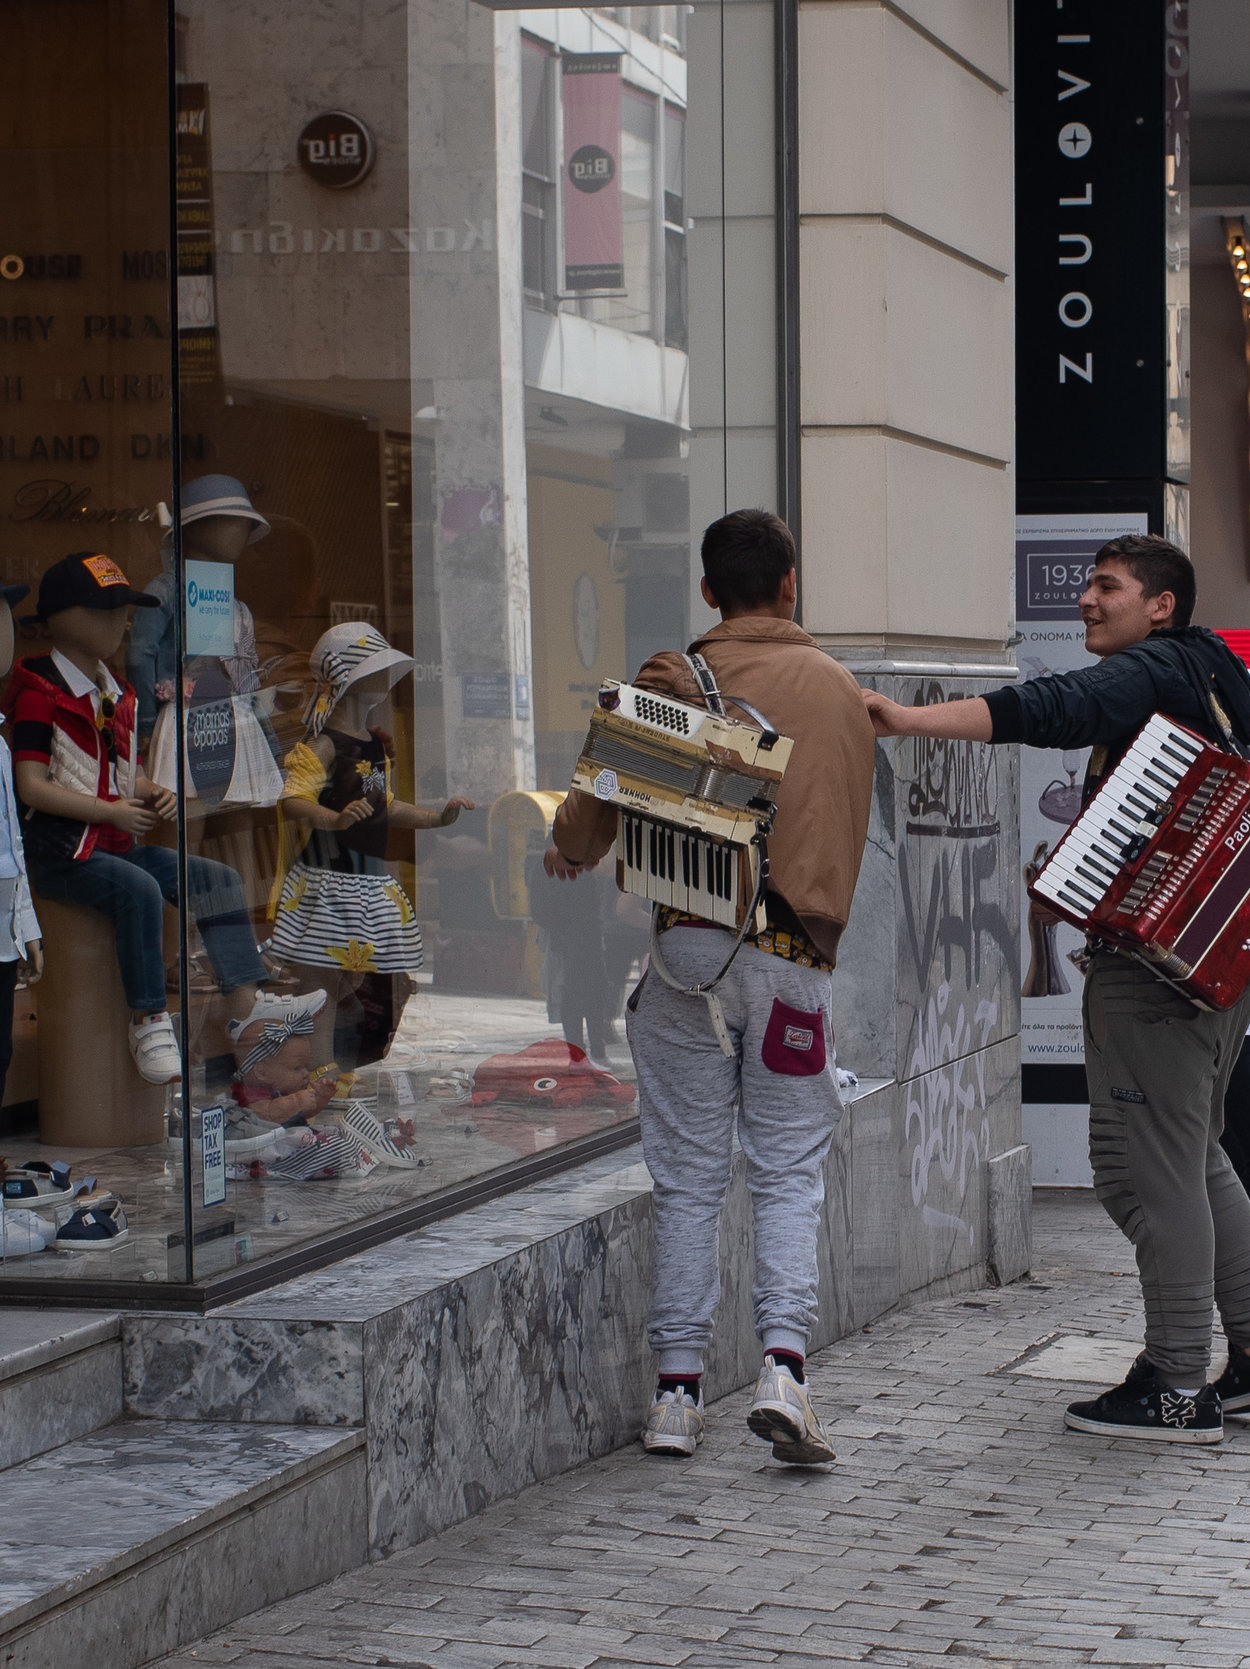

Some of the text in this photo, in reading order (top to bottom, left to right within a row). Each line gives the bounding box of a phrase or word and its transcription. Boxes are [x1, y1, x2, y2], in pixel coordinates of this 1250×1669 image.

[1057, 0, 1093, 384] ZOULOVI
[1031, 632, 1073, 641] ΟΝΟΜΑ
[195, 711, 231, 730] mamas
[199, 728, 229, 752] papas
[618, 785, 652, 803] HOHNER
[1032, 1022, 1046, 1030] όλα
[203, 1112, 222, 1133] SHOP
[204, 1132, 218, 1151] TAX
[205, 1150, 221, 1170] FREE
